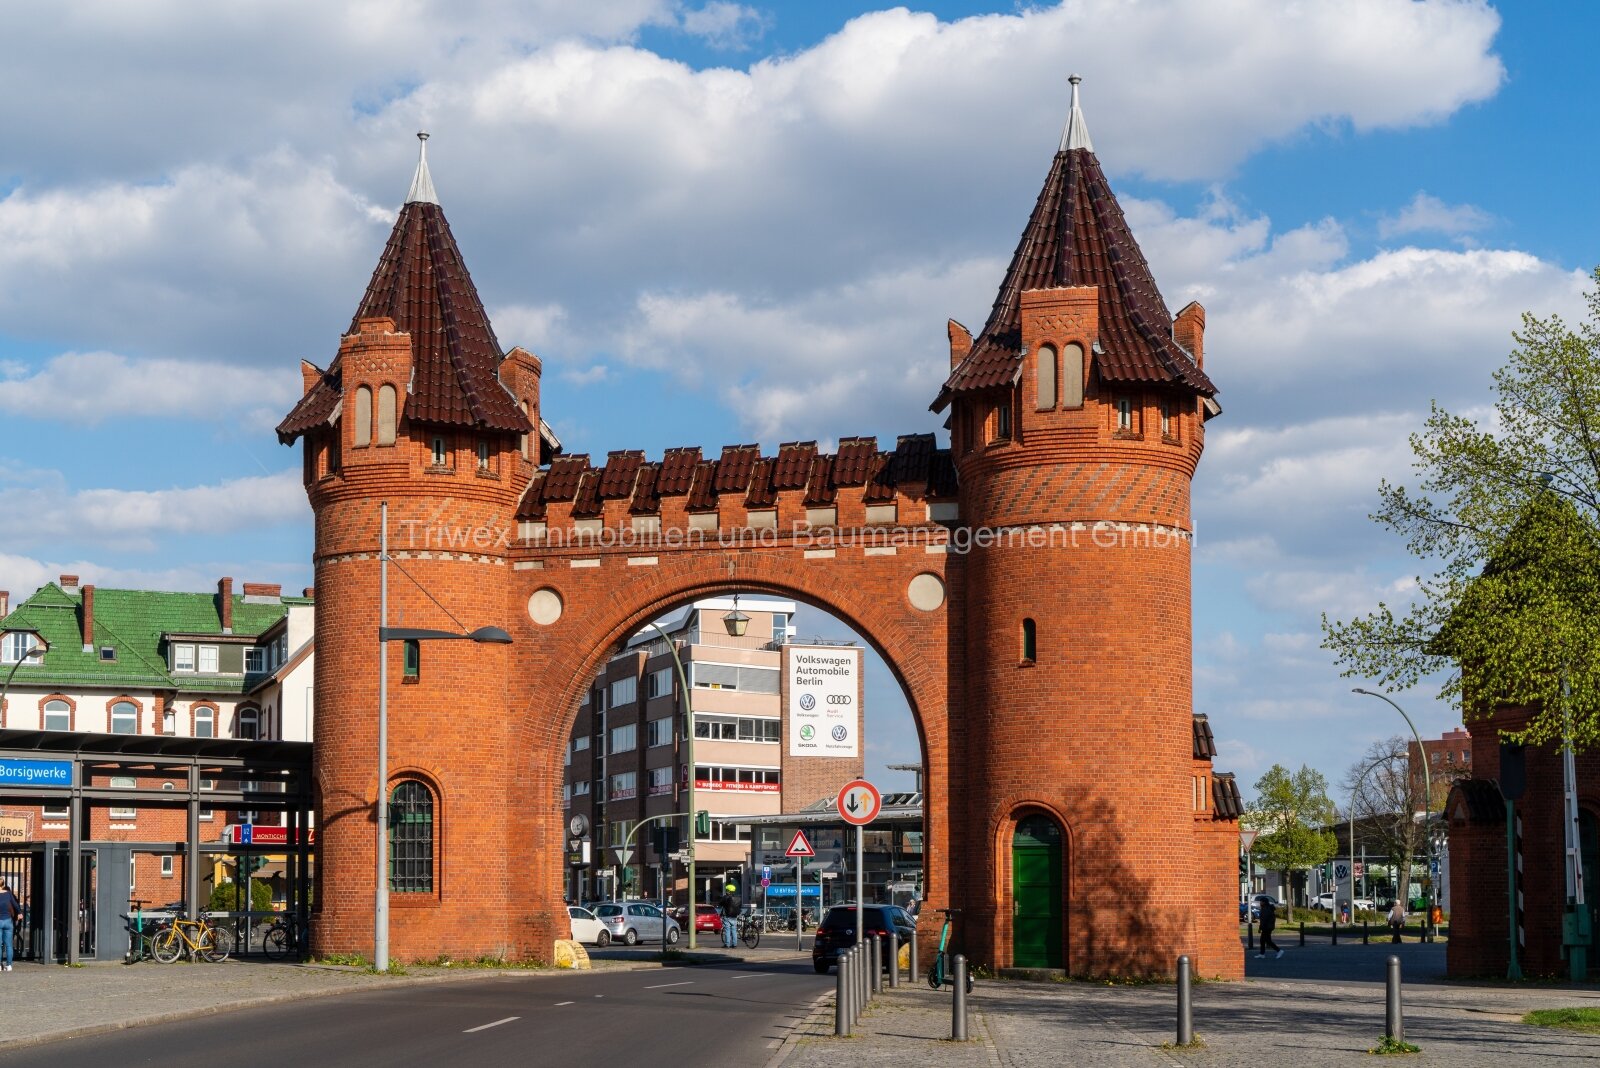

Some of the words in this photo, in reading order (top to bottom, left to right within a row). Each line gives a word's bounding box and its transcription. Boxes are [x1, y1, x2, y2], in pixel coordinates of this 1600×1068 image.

[796, 655, 851, 666] Volkswagen
[796, 666, 850, 676] Automobile
[796, 676, 823, 686] Berlin
[0, 765, 67, 780] Borsigwerke
